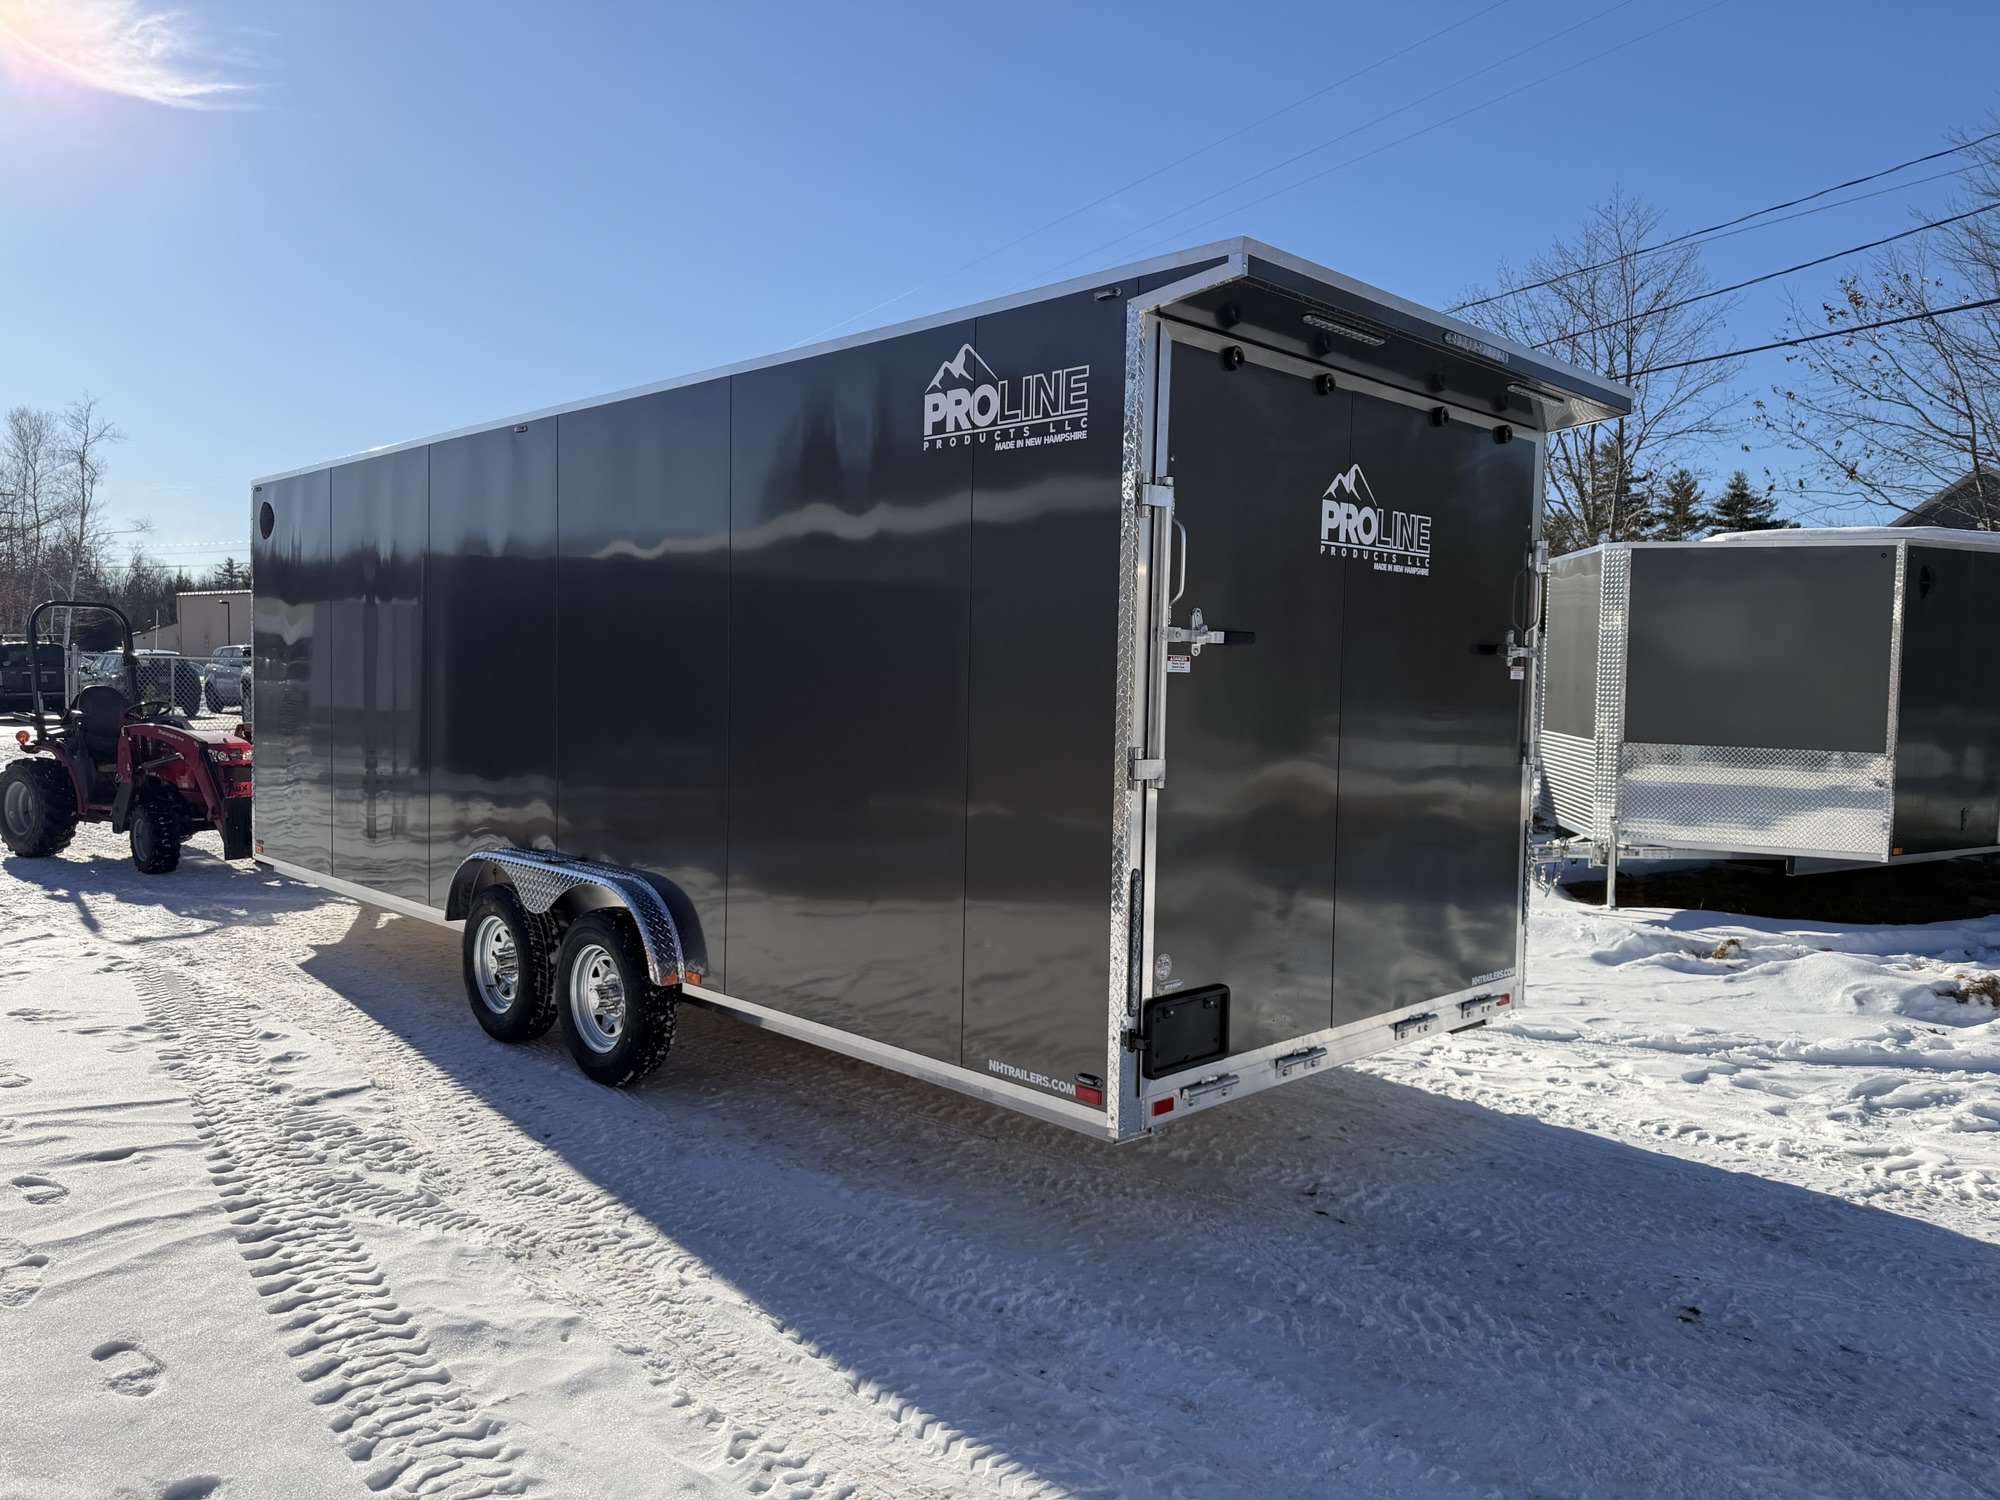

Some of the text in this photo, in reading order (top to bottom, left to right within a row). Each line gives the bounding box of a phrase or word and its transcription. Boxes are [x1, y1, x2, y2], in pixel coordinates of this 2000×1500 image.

[924, 364, 1090, 436] PROLINE
[923, 417, 1088, 451] PRODUCTS LLC
[995, 430, 1088, 451] MADE IN NEW HAMPSHIRE
[1321, 499, 1431, 553] PROLINE
[1320, 545, 1430, 567] PRODUCTS LLC
[1373, 562, 1387, 571] MADE
[1393, 565, 1404, 573] NEW
[1404, 566, 1430, 576] HAMPSHIRE
[1471, 966, 1516, 987] NHTRAILERS.COM
[988, 1059, 1076, 1096] NHTRAILERS.COM
